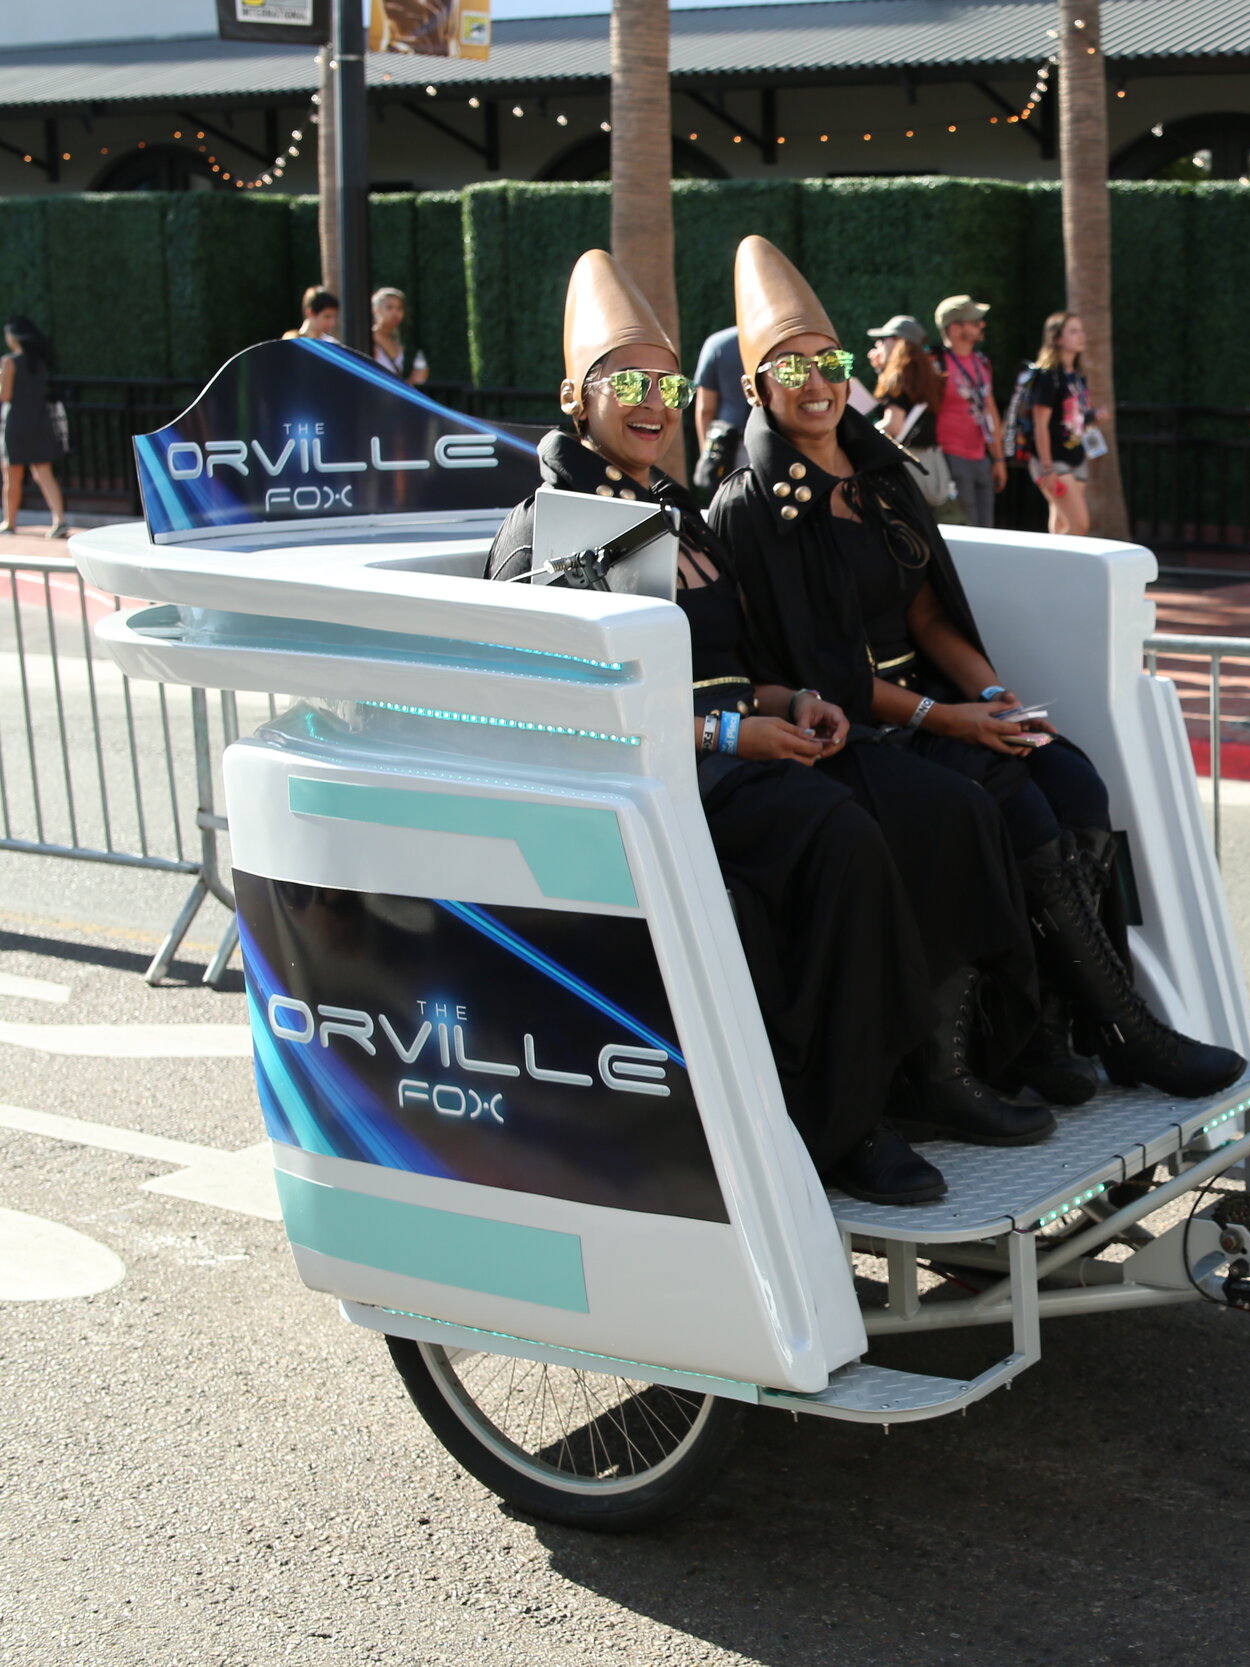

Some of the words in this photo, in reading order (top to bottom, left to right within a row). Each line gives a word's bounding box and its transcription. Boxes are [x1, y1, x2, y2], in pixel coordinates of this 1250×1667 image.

[283, 422, 326, 436] THE
[166, 433, 499, 481] ORVILLE
[265, 484, 353, 513] FOX
[416, 1000, 468, 1021] THE
[268, 993, 671, 1097] ORVILLE
[398, 1078, 505, 1124] FOX
